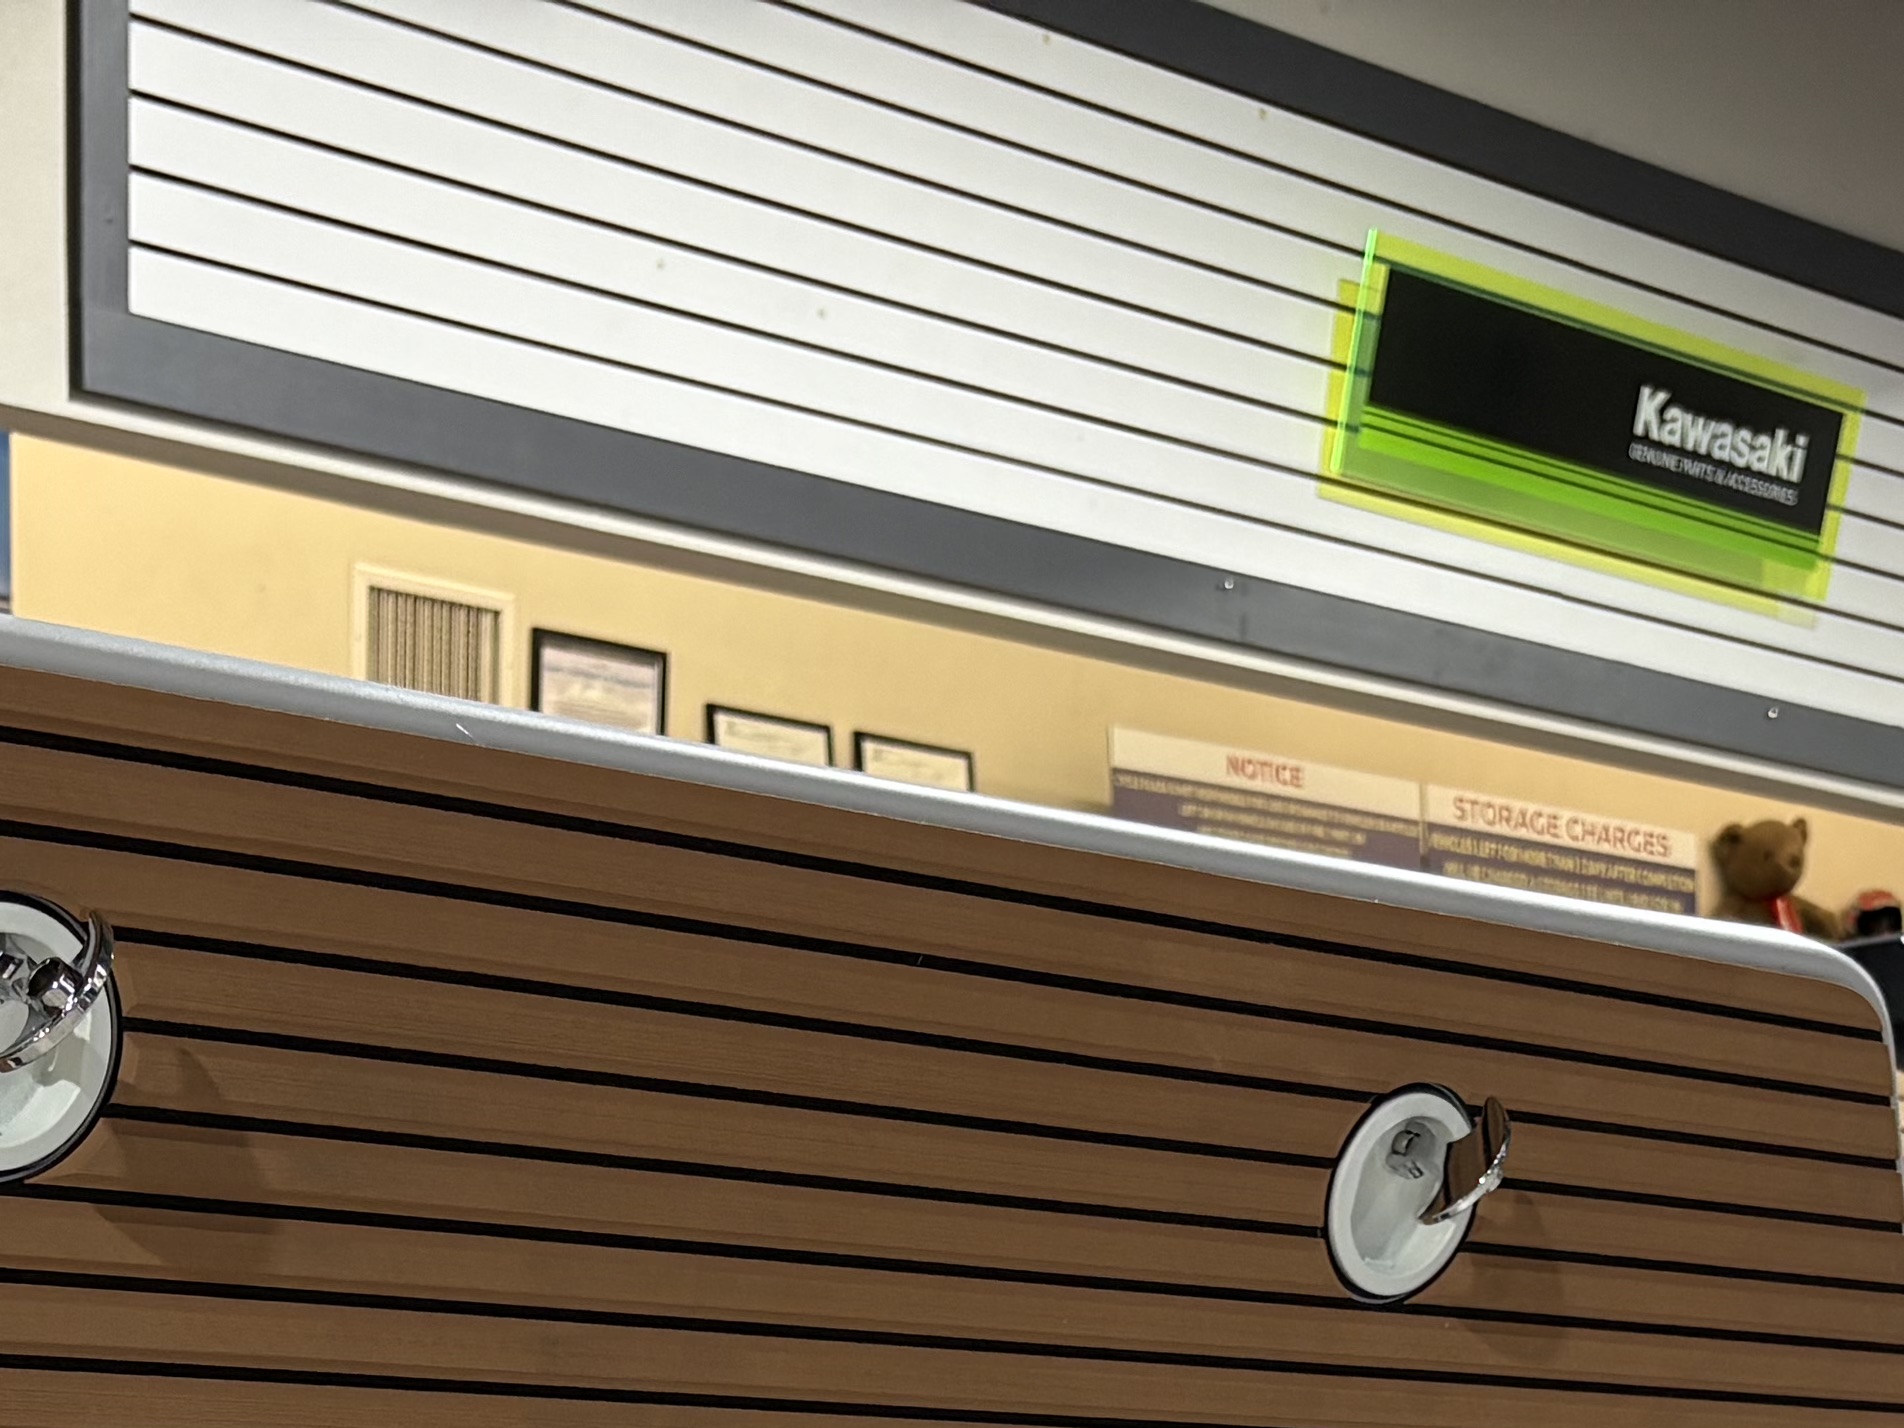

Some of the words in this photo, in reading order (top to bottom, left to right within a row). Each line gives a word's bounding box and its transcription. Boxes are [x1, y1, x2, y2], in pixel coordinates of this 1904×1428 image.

[1633, 384, 1810, 484] Kawasaki
[1225, 755, 1304, 788] NOTICE
[1452, 795, 1562, 839] STORAGE
[1564, 814, 1673, 859] CHARGES
